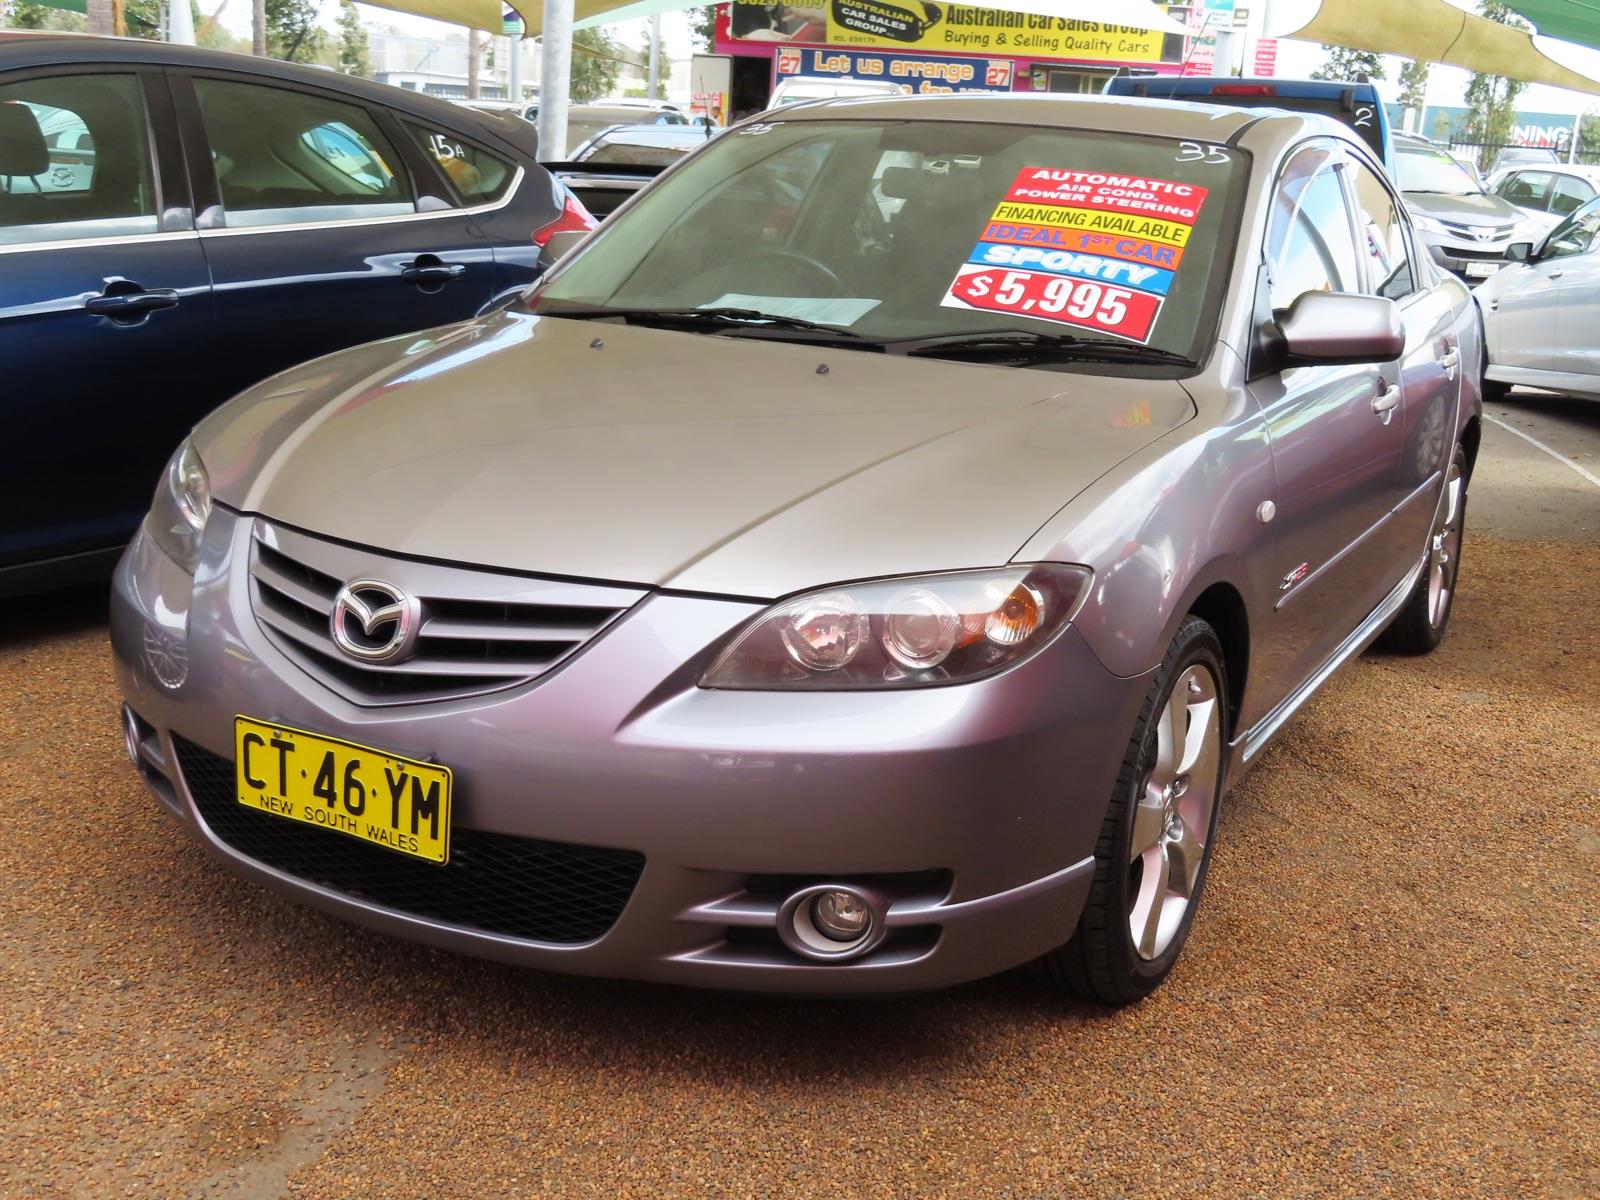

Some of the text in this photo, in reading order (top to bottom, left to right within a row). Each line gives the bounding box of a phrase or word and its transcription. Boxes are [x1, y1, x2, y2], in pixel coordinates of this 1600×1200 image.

[838, 0, 914, 23] AUSTRALIAN
[842, 8, 907, 31] CAR SALES
[946, 6, 1024, 28] Australian
[1028, 14, 1052, 30] Car
[845, 18, 887, 34] GROUP
[945, 31, 1150, 54] Buying & Selling Quality Cars
[779, 57, 800, 73] 27
[814, 52, 974, 84] Let us arrange
[987, 68, 1009, 86] 27
[1175, 141, 1231, 164] 35
[1031, 170, 1193, 196] AUTOMATIC
[1057, 183, 1159, 202] AIR COND.
[1015, 188, 1194, 218] POWER STEERING
[996, 206, 1185, 242] FINANCING AVAILABLE
[985, 225, 1067, 245] IDEAL
[1115, 238, 1176, 266] CAR
[983, 245, 1159, 285] SPORTY
[260, 794, 419, 852] NEW SOUTH WALES
